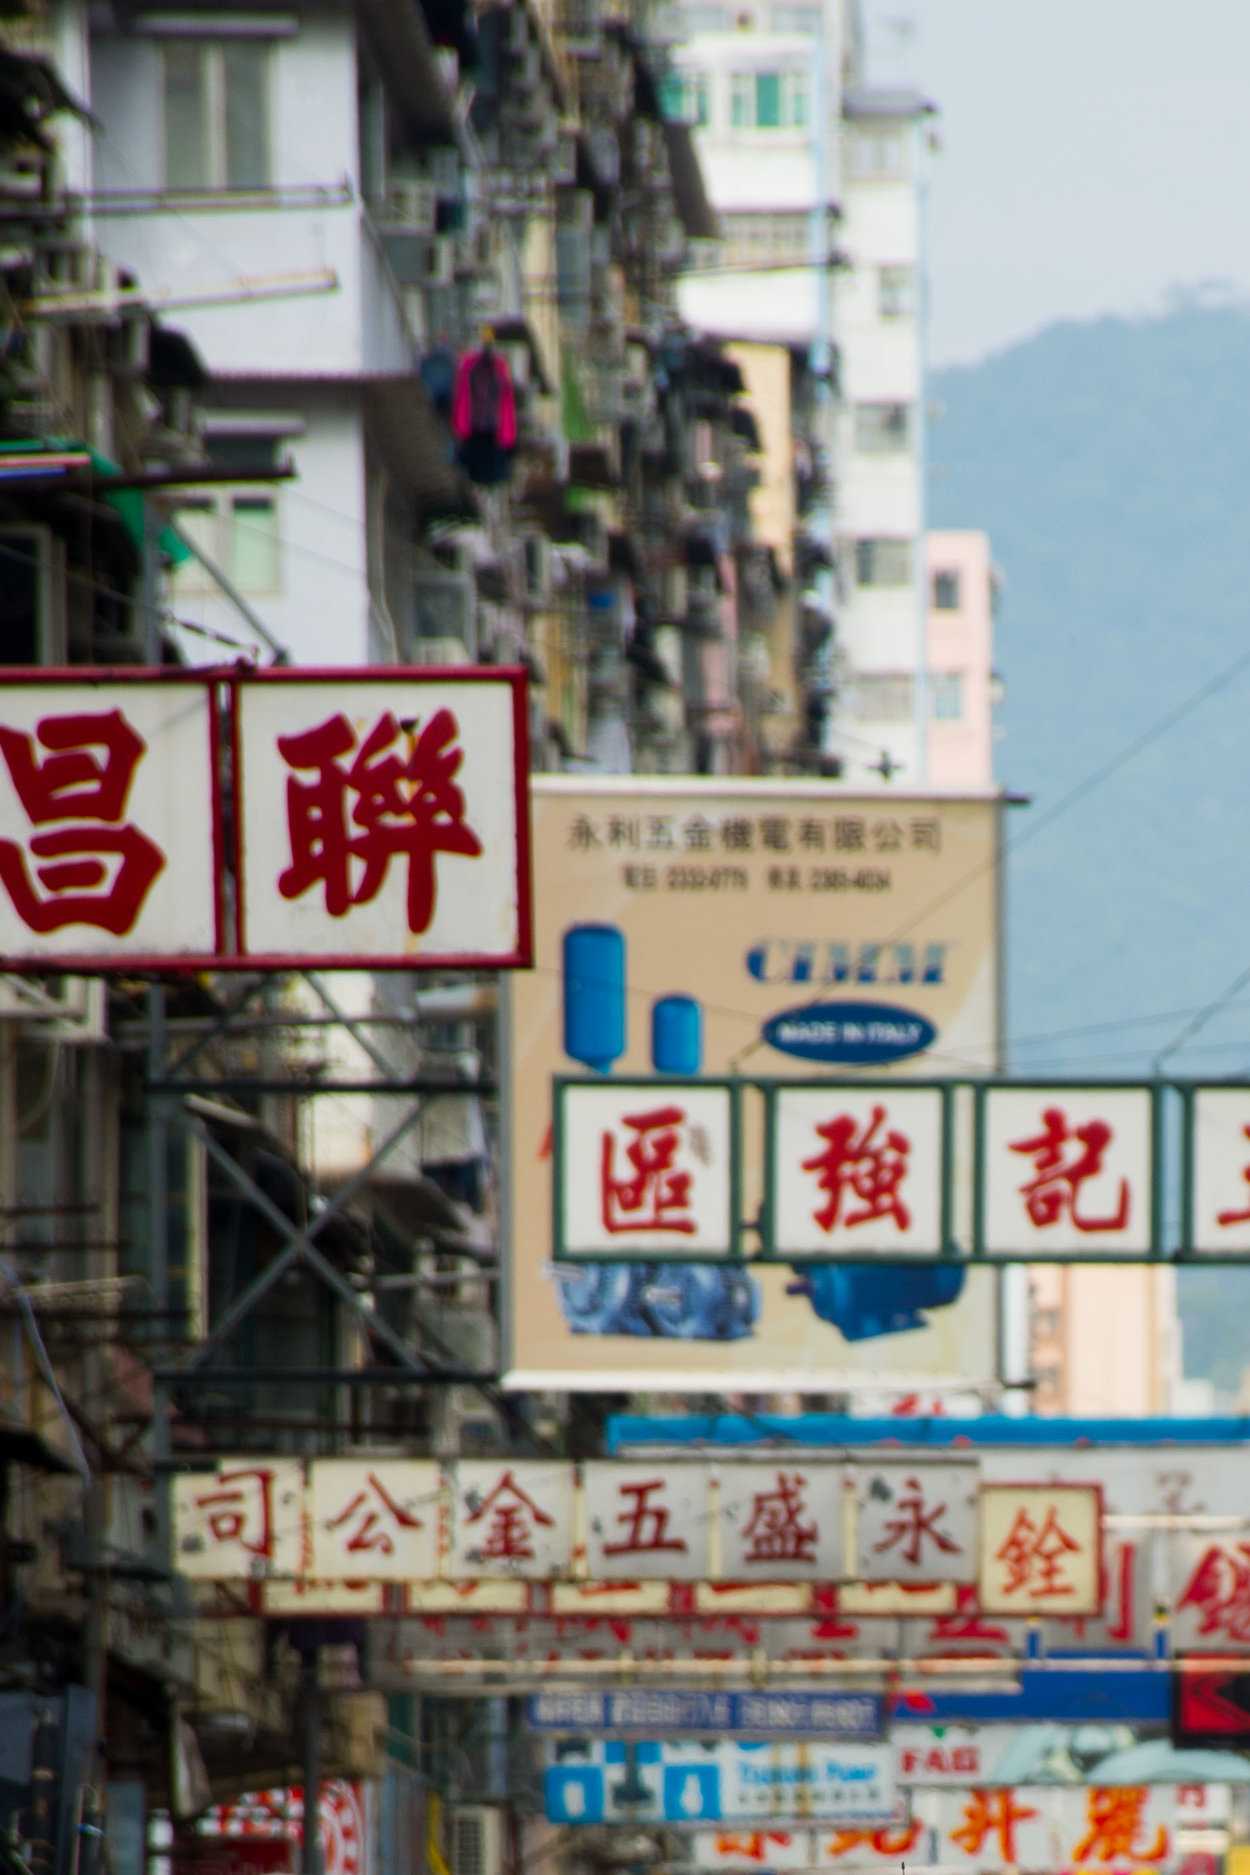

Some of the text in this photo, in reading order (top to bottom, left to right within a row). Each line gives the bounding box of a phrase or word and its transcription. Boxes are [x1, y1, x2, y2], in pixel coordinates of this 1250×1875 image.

[778, 1022, 923, 1045] MADE IN ITALY
